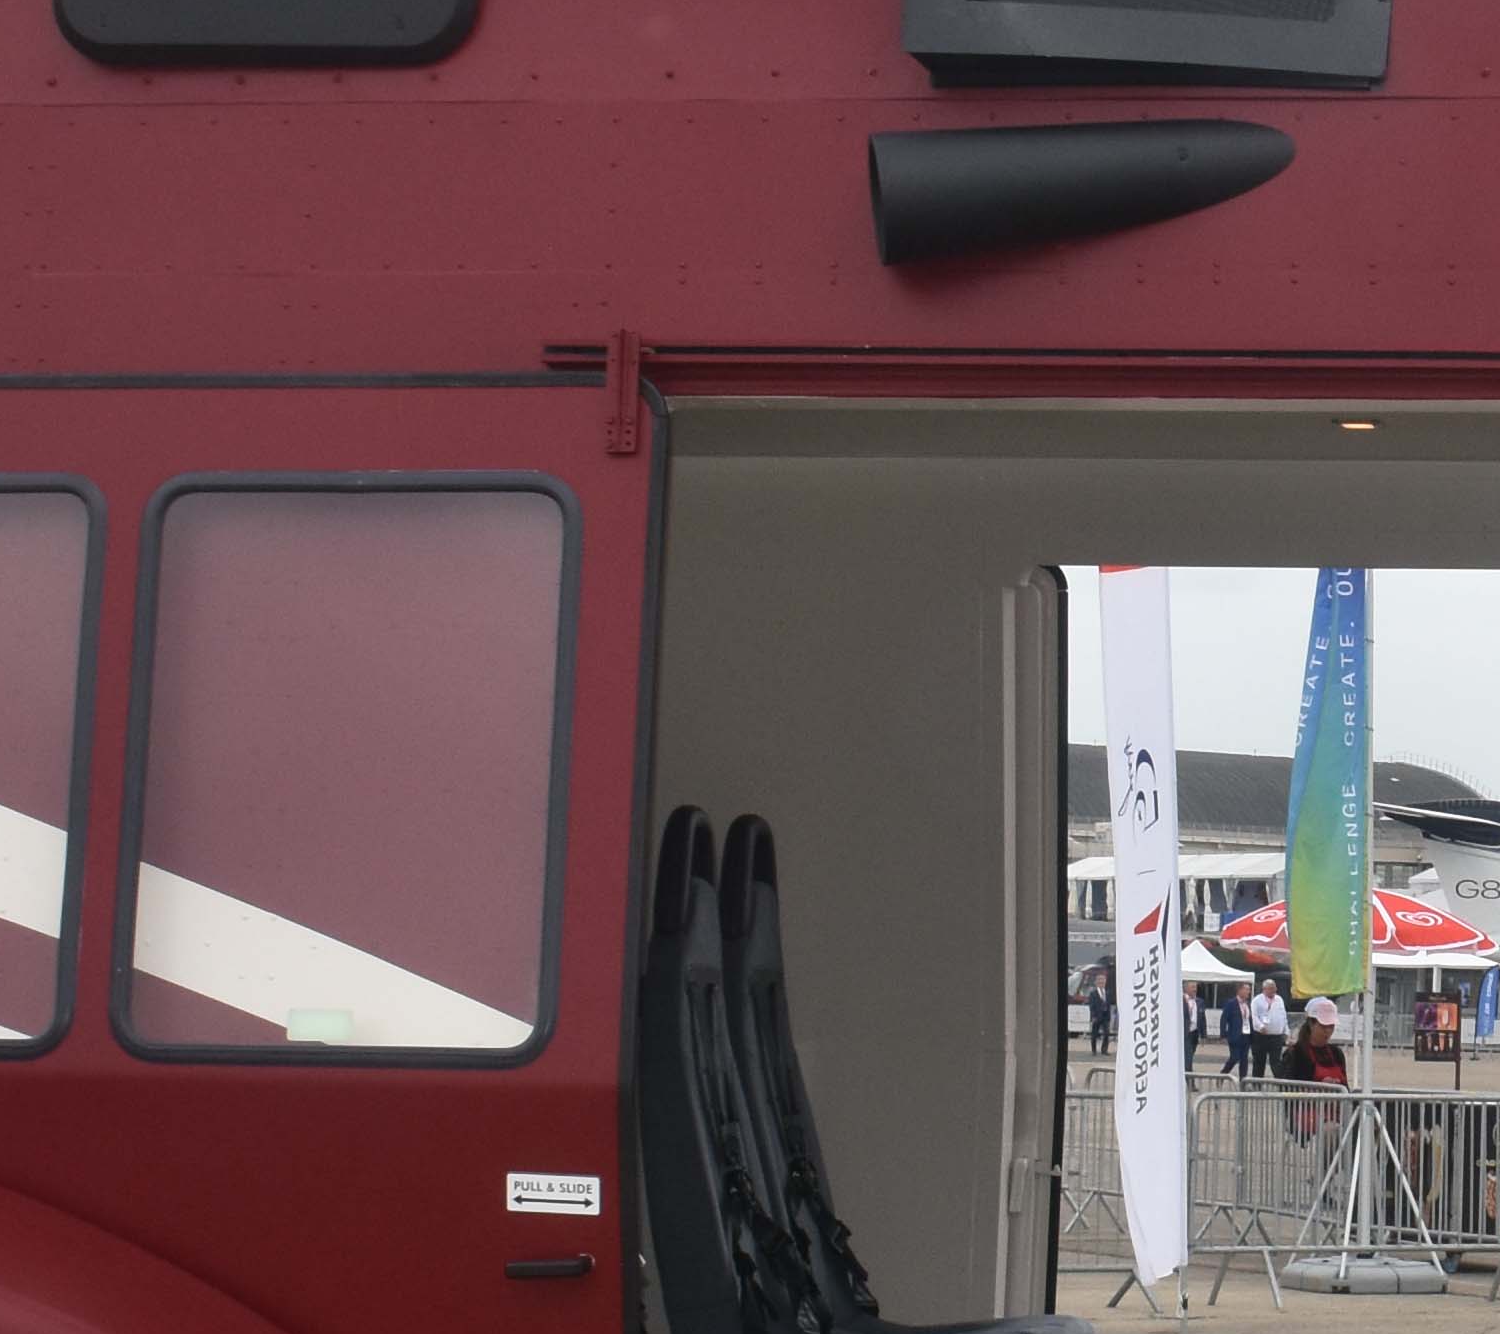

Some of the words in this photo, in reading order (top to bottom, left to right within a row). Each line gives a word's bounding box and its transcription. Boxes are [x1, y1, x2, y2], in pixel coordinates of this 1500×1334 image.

[513, 1180, 543, 1193] PULL
[546, 1182, 555, 1193] &
[559, 1182, 594, 1195] SLIDE
